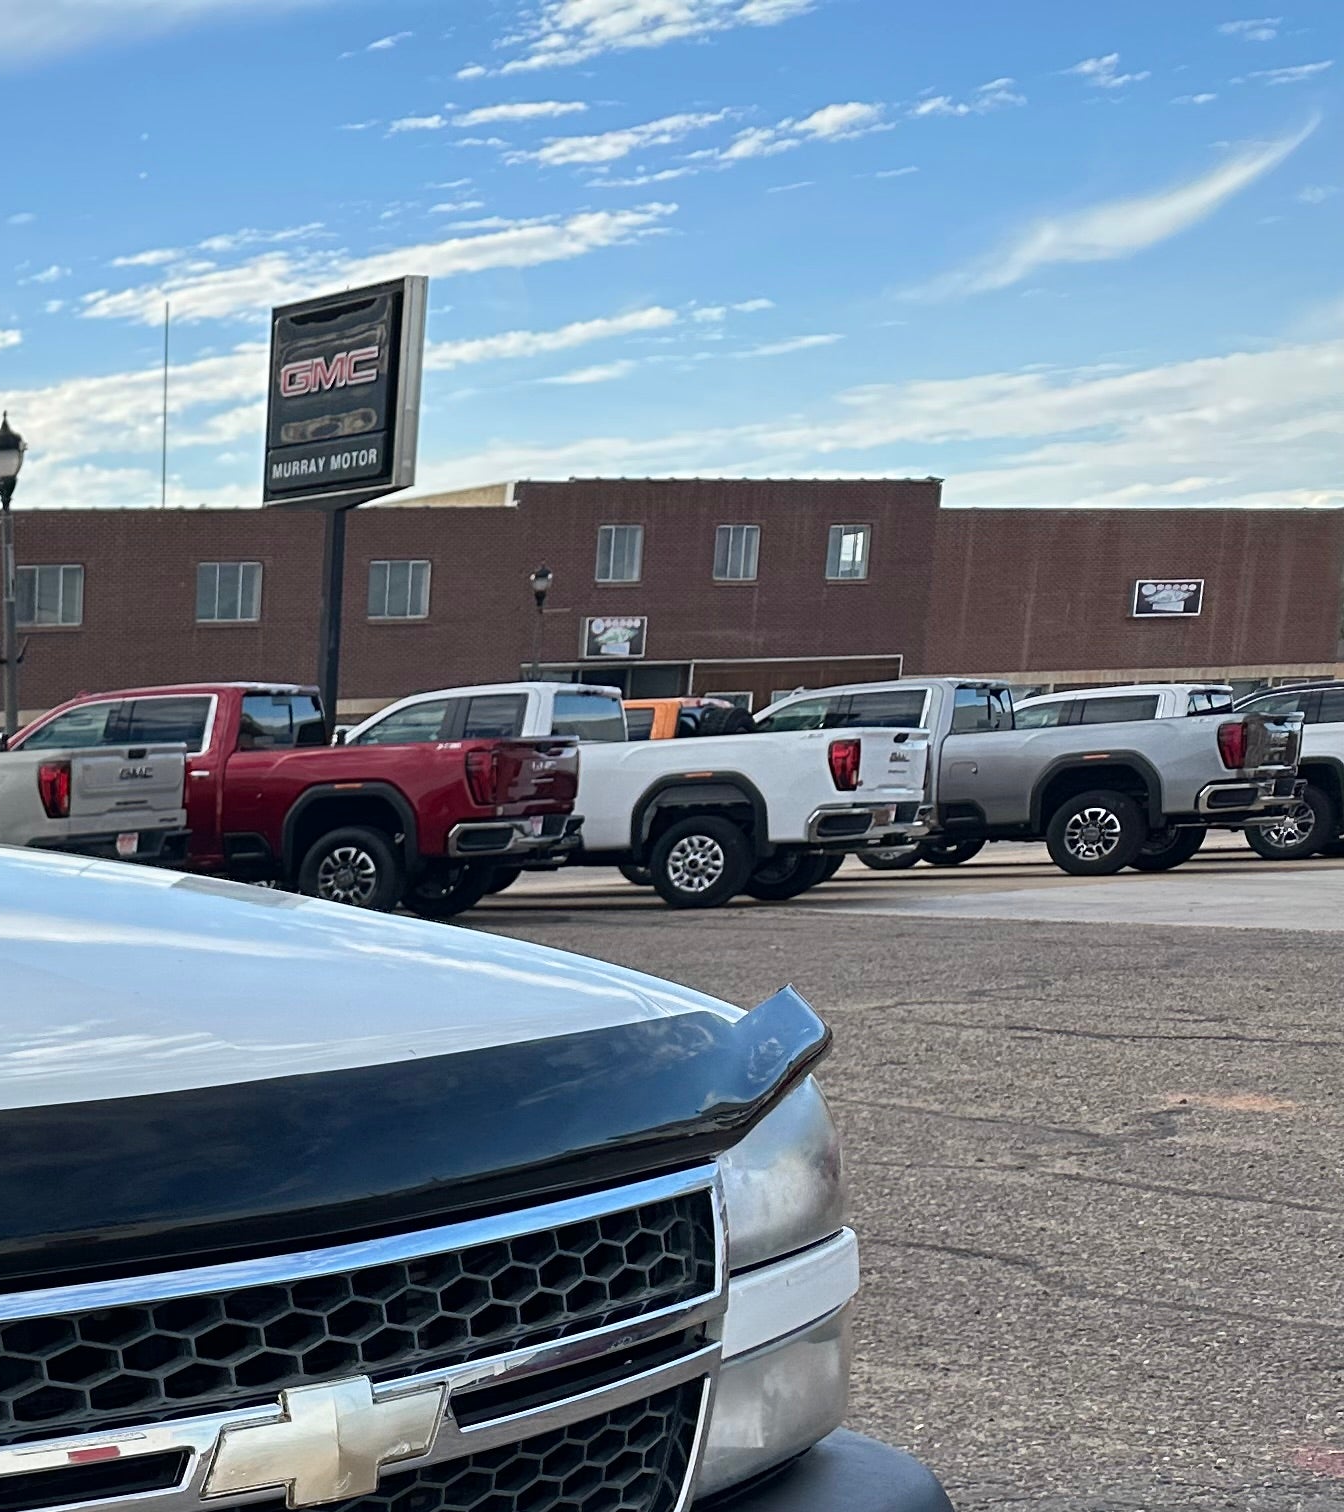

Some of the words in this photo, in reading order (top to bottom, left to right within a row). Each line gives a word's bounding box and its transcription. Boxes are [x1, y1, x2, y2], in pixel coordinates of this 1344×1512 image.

[280, 346, 379, 398] GMC
[272, 456, 326, 480] MURRAY
[330, 448, 378, 471] MOTOR
